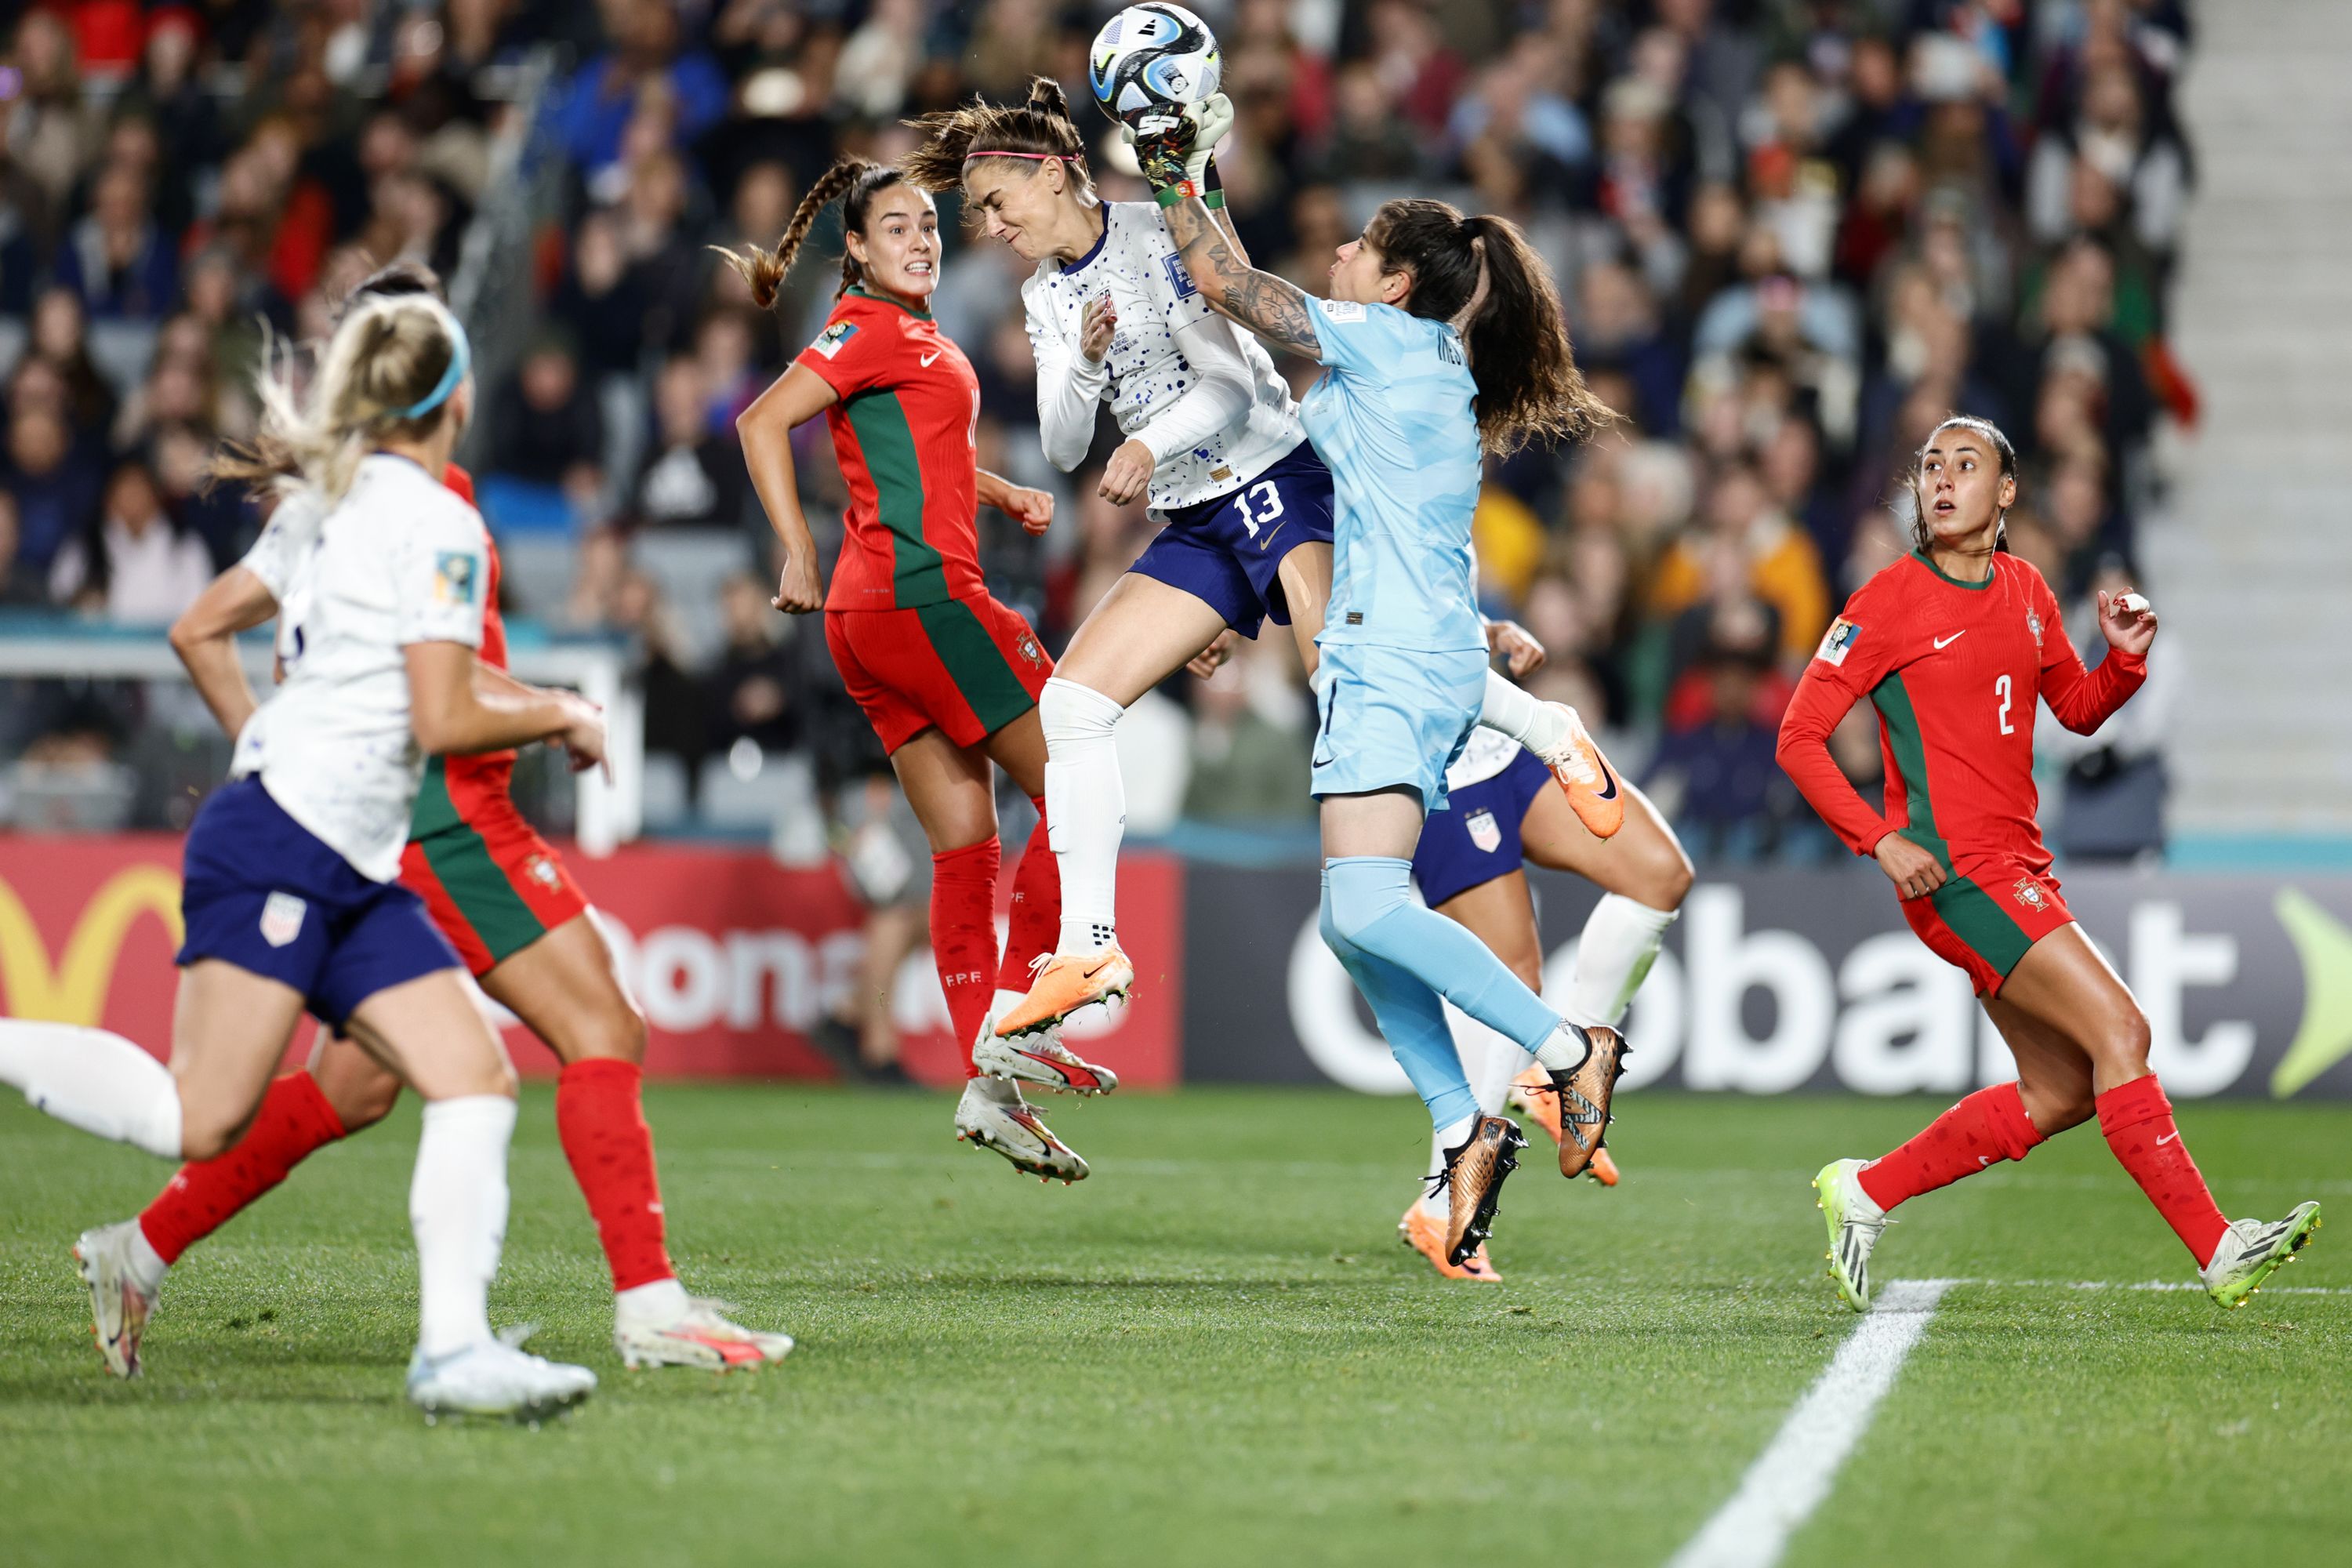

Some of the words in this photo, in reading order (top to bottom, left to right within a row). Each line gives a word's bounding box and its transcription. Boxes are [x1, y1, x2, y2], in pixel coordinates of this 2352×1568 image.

[1233, 479, 1285, 539] 13
[1995, 674, 2014, 735] 2
[1286, 878, 2256, 1098] Gobat
